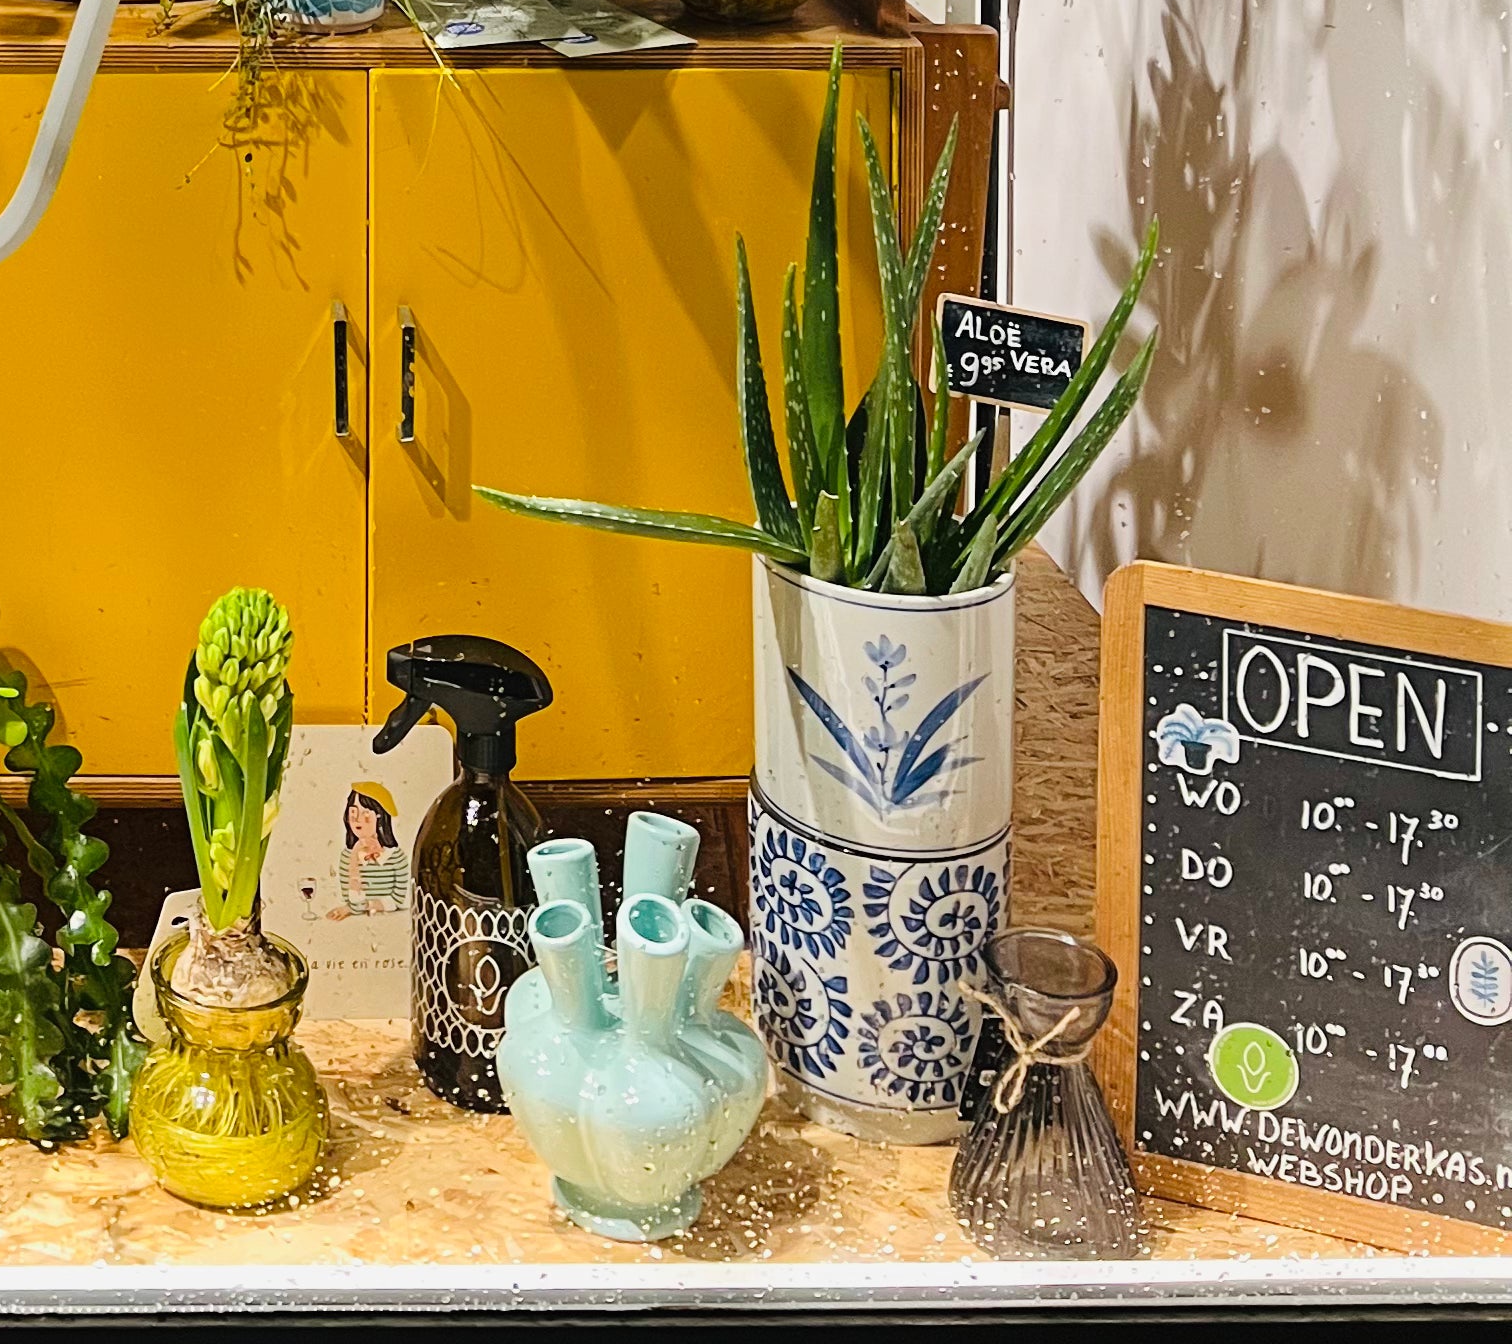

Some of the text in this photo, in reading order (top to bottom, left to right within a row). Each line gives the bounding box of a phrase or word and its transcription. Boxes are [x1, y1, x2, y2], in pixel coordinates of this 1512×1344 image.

[955, 310, 1021, 347] ALOË
[1010, 349, 1072, 378] VERA
[1236, 645, 1446, 759] OPEN
[1176, 773, 1241, 815] WO
[1181, 848, 1233, 888] DO
[1174, 917, 1233, 961] VR
[1170, 989, 1224, 1032] ZA
[1247, 1147, 1413, 1202] WEBSHOP
